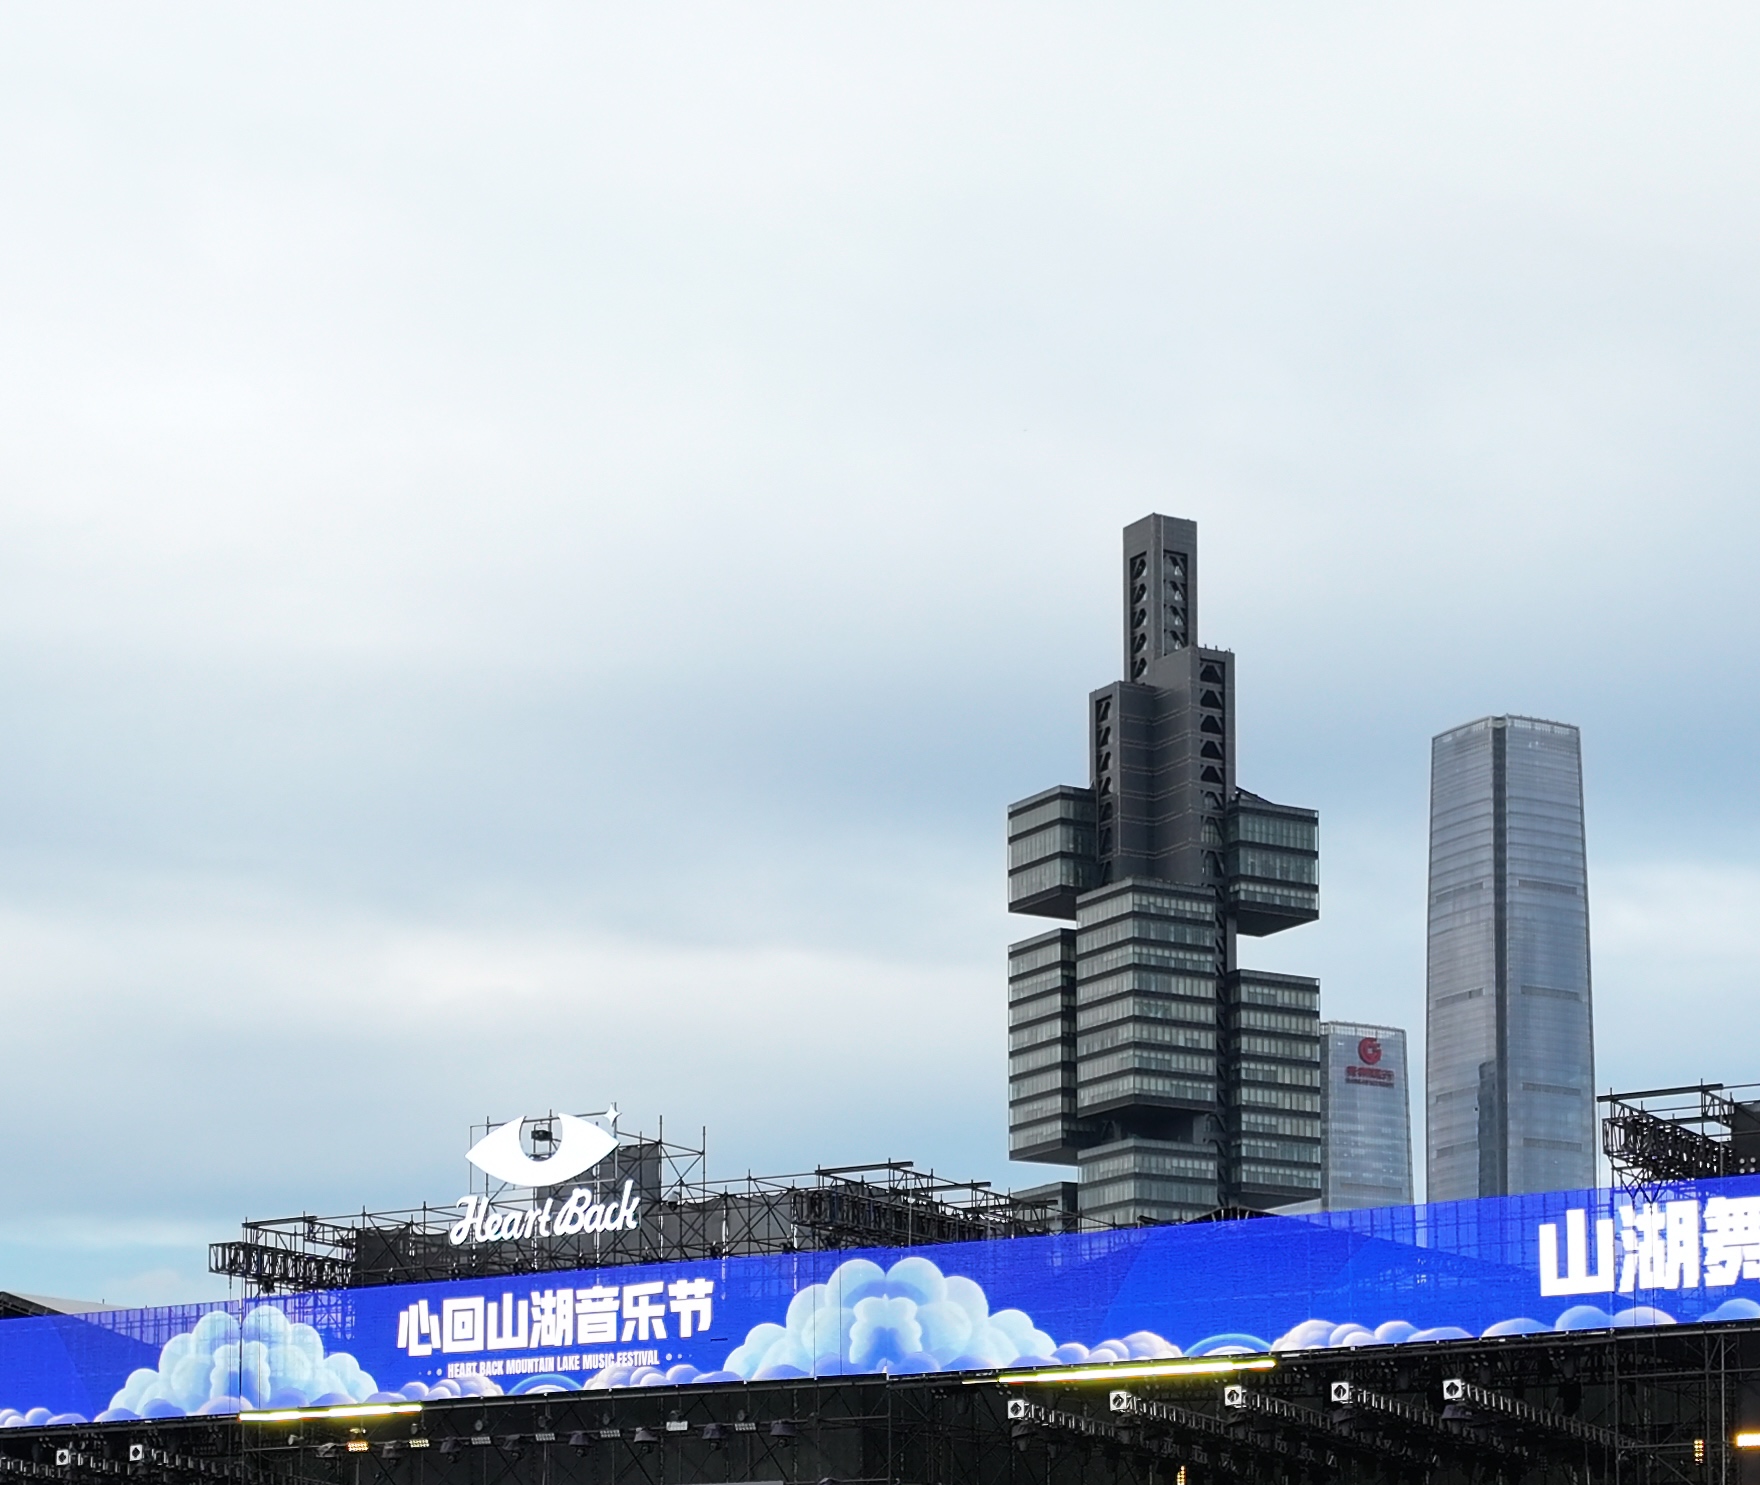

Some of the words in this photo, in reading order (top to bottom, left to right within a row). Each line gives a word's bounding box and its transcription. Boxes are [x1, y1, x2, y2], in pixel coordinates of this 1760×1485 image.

[449, 1195, 555, 1245] Heart
[553, 1179, 640, 1236] Back
[397, 1278, 714, 1356] 心回山湖音乐节
[447, 1362, 479, 1378] HEART
[479, 1361, 504, 1377] BACK
[506, 1358, 555, 1375] MOUNTAIN
[556, 1355, 581, 1372] LAKE
[582, 1352, 616, 1369] MUSIC
[616, 1349, 660, 1367] FESTIVAL
